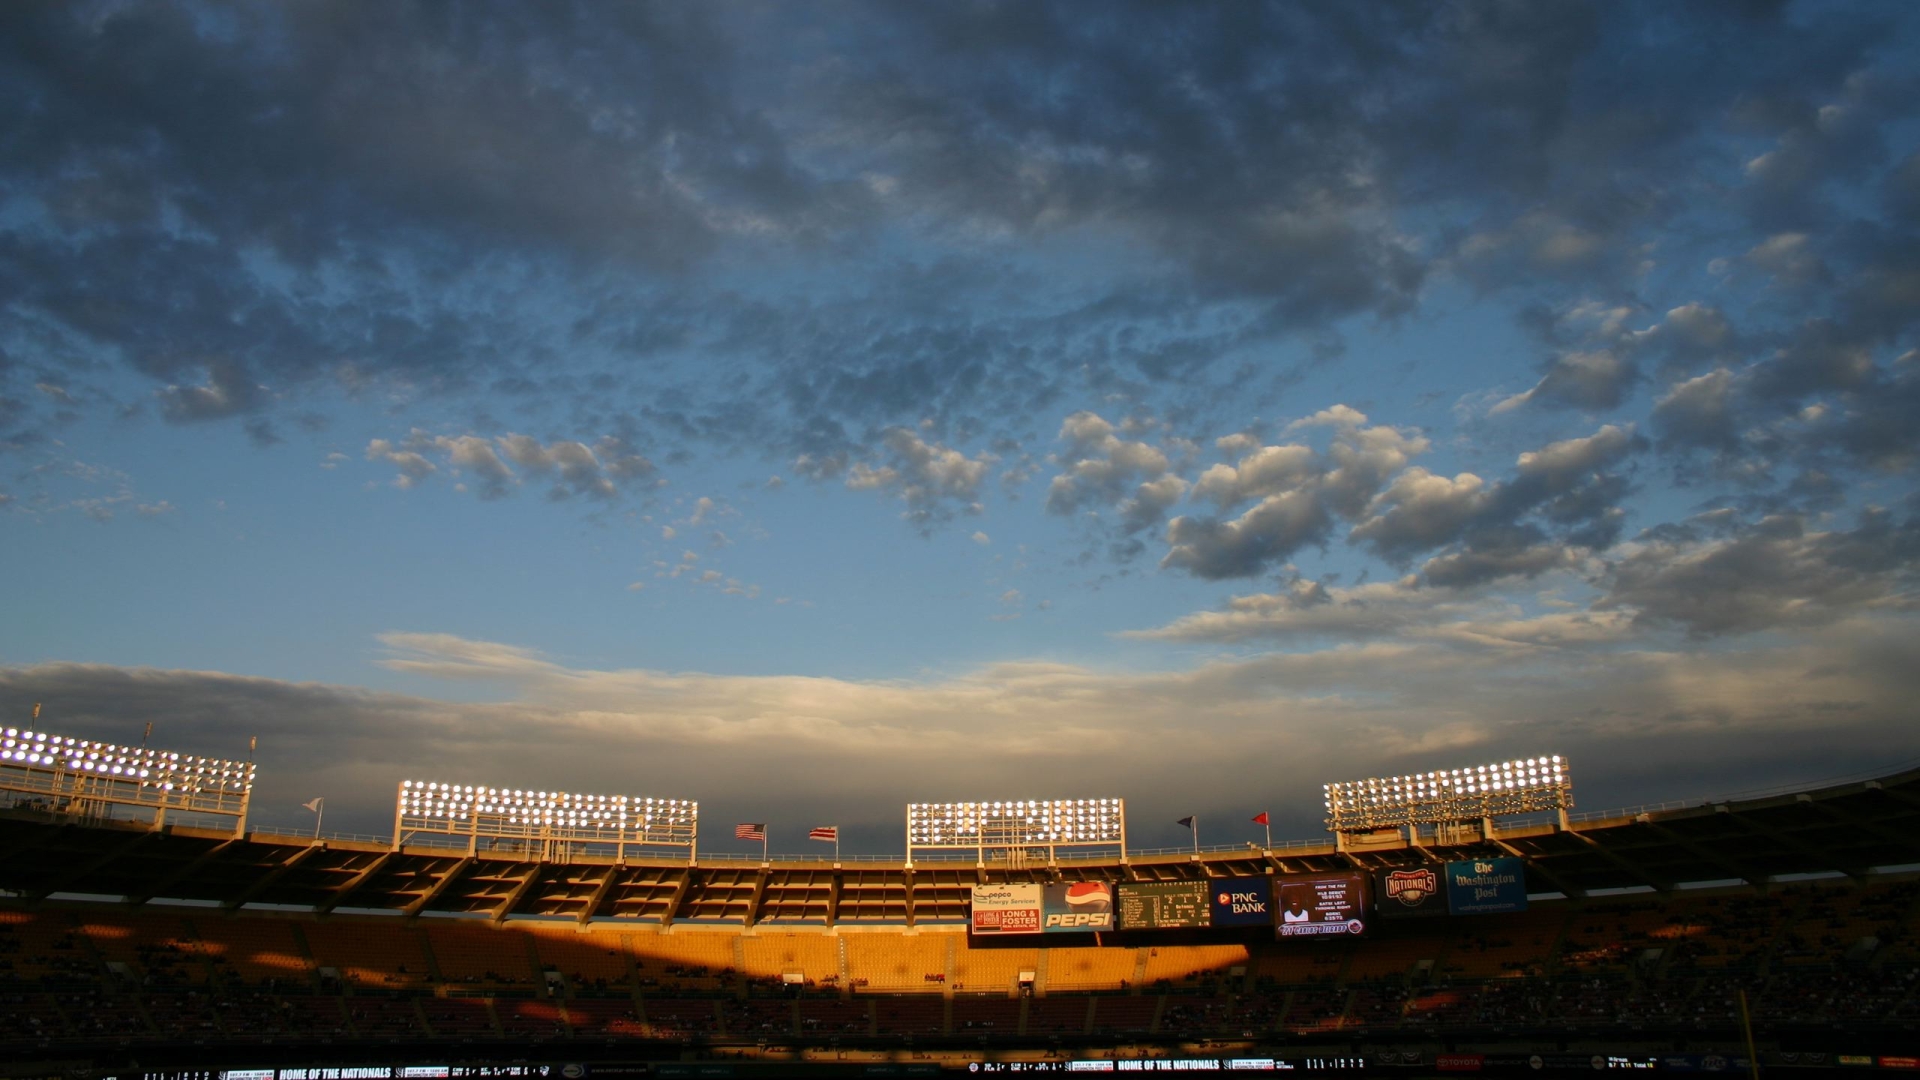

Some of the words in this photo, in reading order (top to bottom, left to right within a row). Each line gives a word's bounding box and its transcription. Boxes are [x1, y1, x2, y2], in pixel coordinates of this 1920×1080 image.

[1474, 862, 1493, 873] The
[1389, 877, 1433, 894] NATIONALS
[1456, 874, 1515, 886] Washington
[1232, 892, 1257, 903] PNC
[1475, 887, 1497, 900] Post
[1232, 903, 1266, 913] BANK
[1046, 913, 1110, 927] PEPSI
[1118, 1061, 1142, 1070] HOME
[1144, 1060, 1154, 1070] OF
[1156, 1060, 1172, 1070] THE
[1173, 1059, 1220, 1069] NATIONALS
[279, 1069, 307, 1080] HOME
[308, 1069, 321, 1079] OF
[322, 1068, 340, 1079] THE
[340, 1067, 391, 1078] NATIONALS
